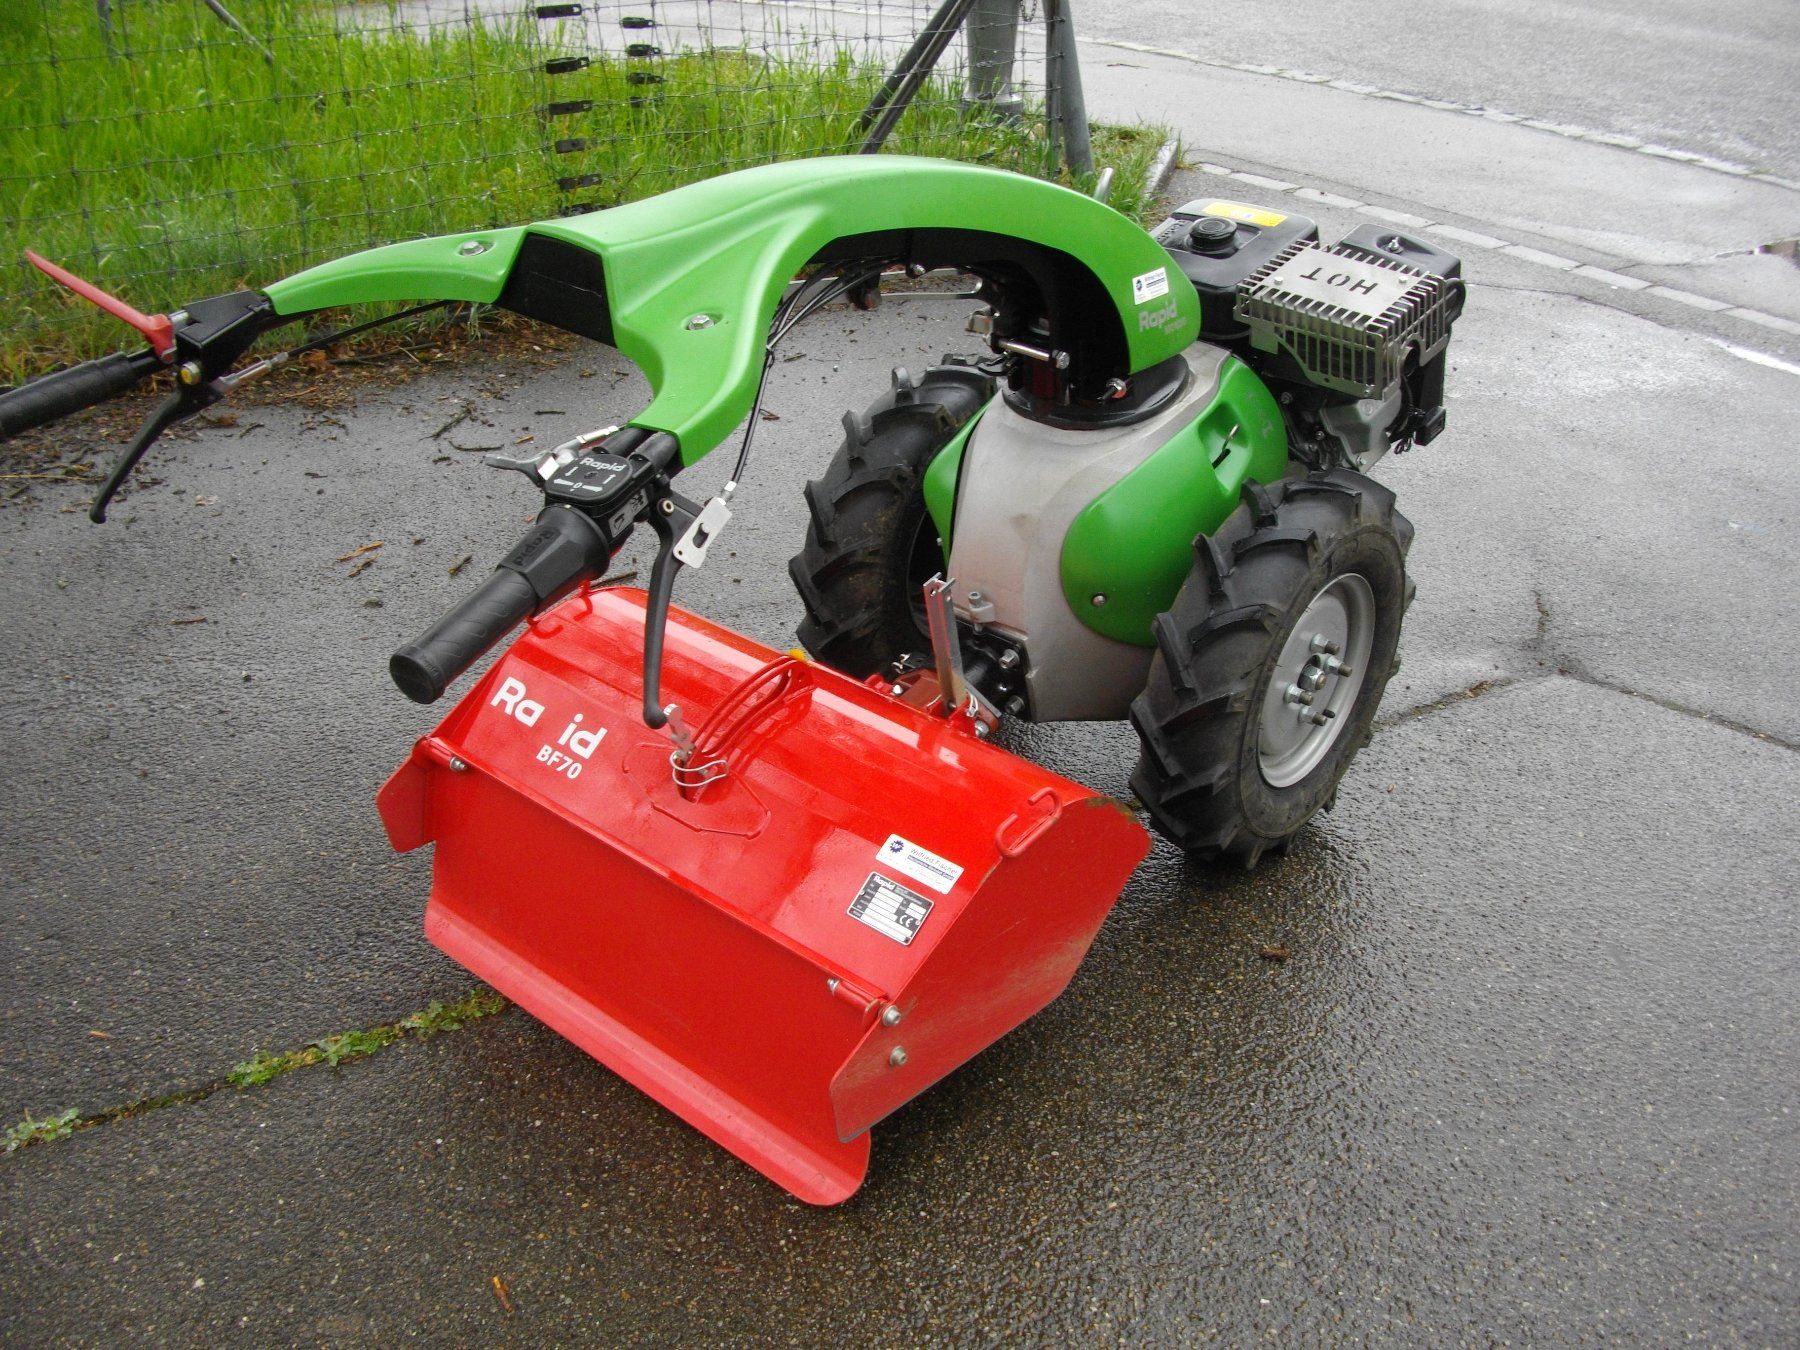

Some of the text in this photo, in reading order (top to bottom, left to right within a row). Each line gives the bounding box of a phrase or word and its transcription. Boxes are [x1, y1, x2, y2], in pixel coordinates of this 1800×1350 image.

[1299, 267, 1379, 295] HOT
[1138, 298, 1178, 332] Rapid
[580, 457, 627, 472] Rapid
[536, 744, 583, 780] BF70
[873, 875, 896, 891] Rapid
